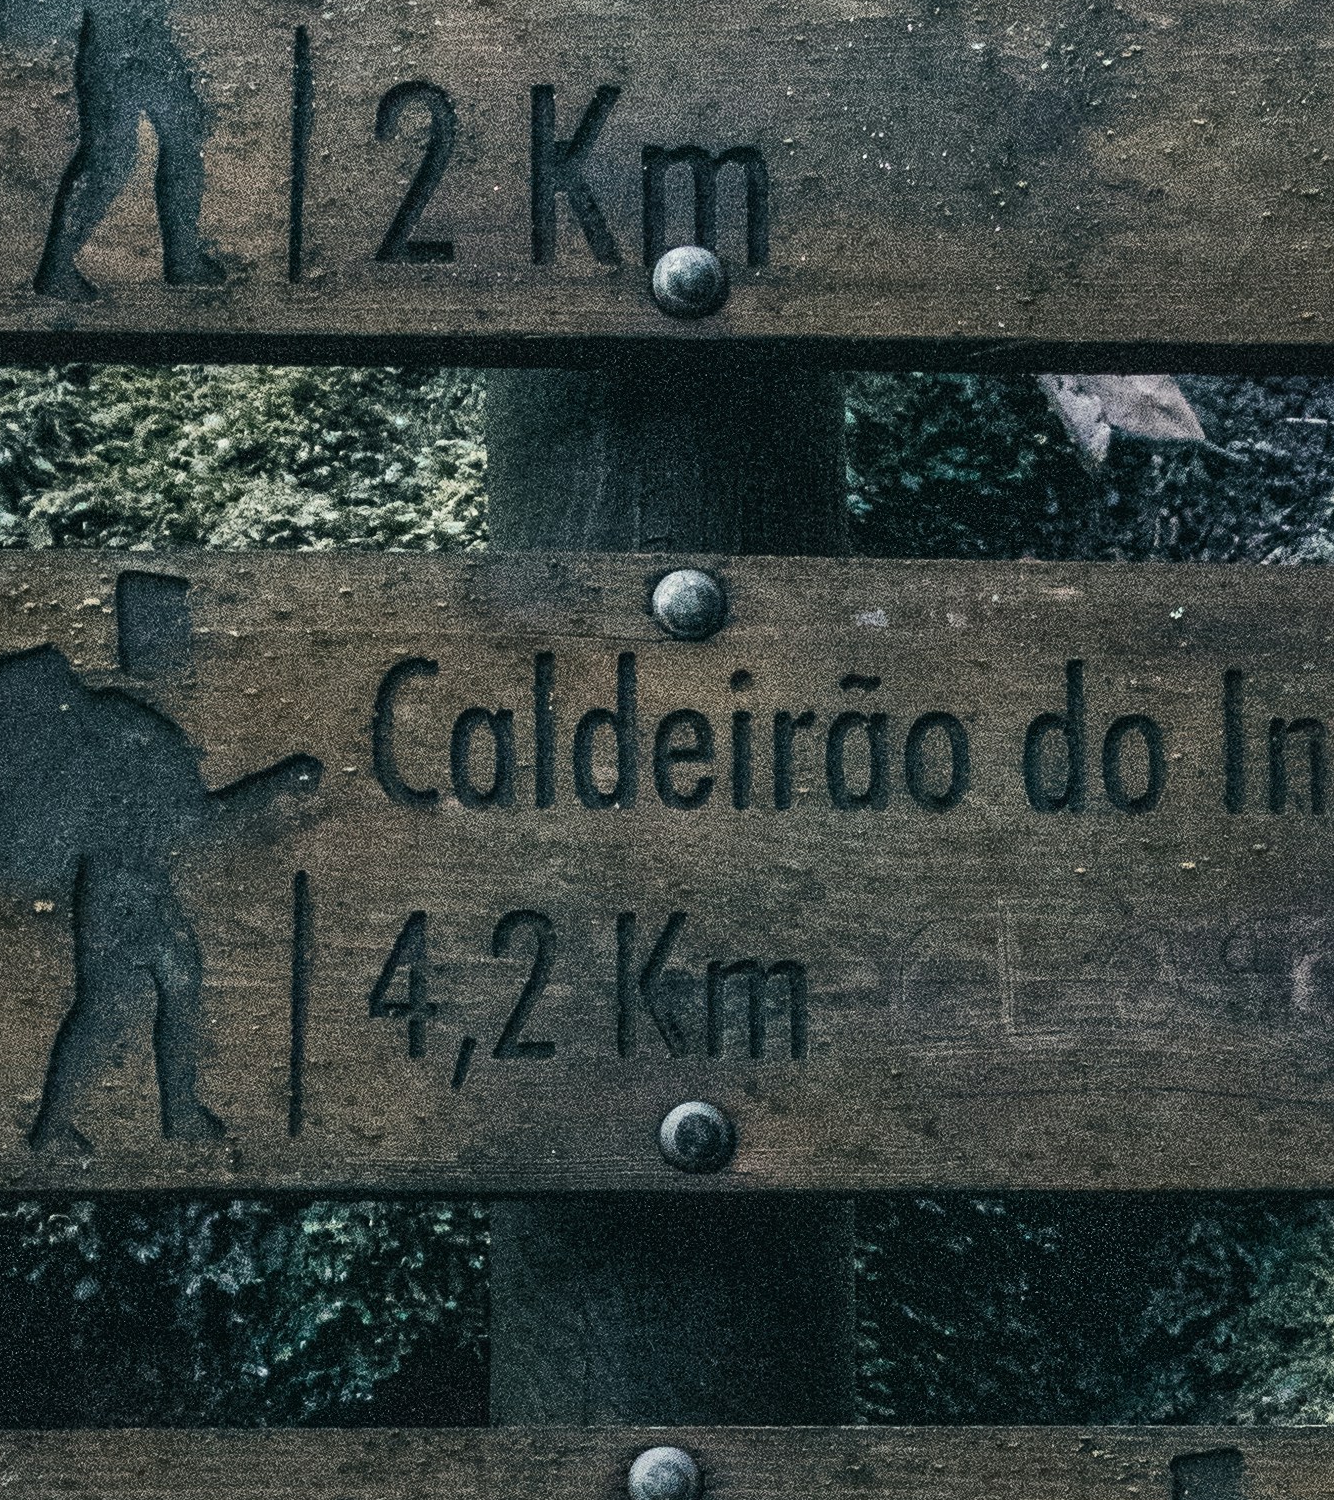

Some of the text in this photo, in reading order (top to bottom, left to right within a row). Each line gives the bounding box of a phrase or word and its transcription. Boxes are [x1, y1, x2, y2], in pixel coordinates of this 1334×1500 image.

[373, 80, 773, 270] 2 Km
[369, 650, 973, 813] Caldeirão
[1023, 659, 1167, 816] do
[367, 908, 557, 1092] 4,2
[616, 910, 809, 1062] Km
